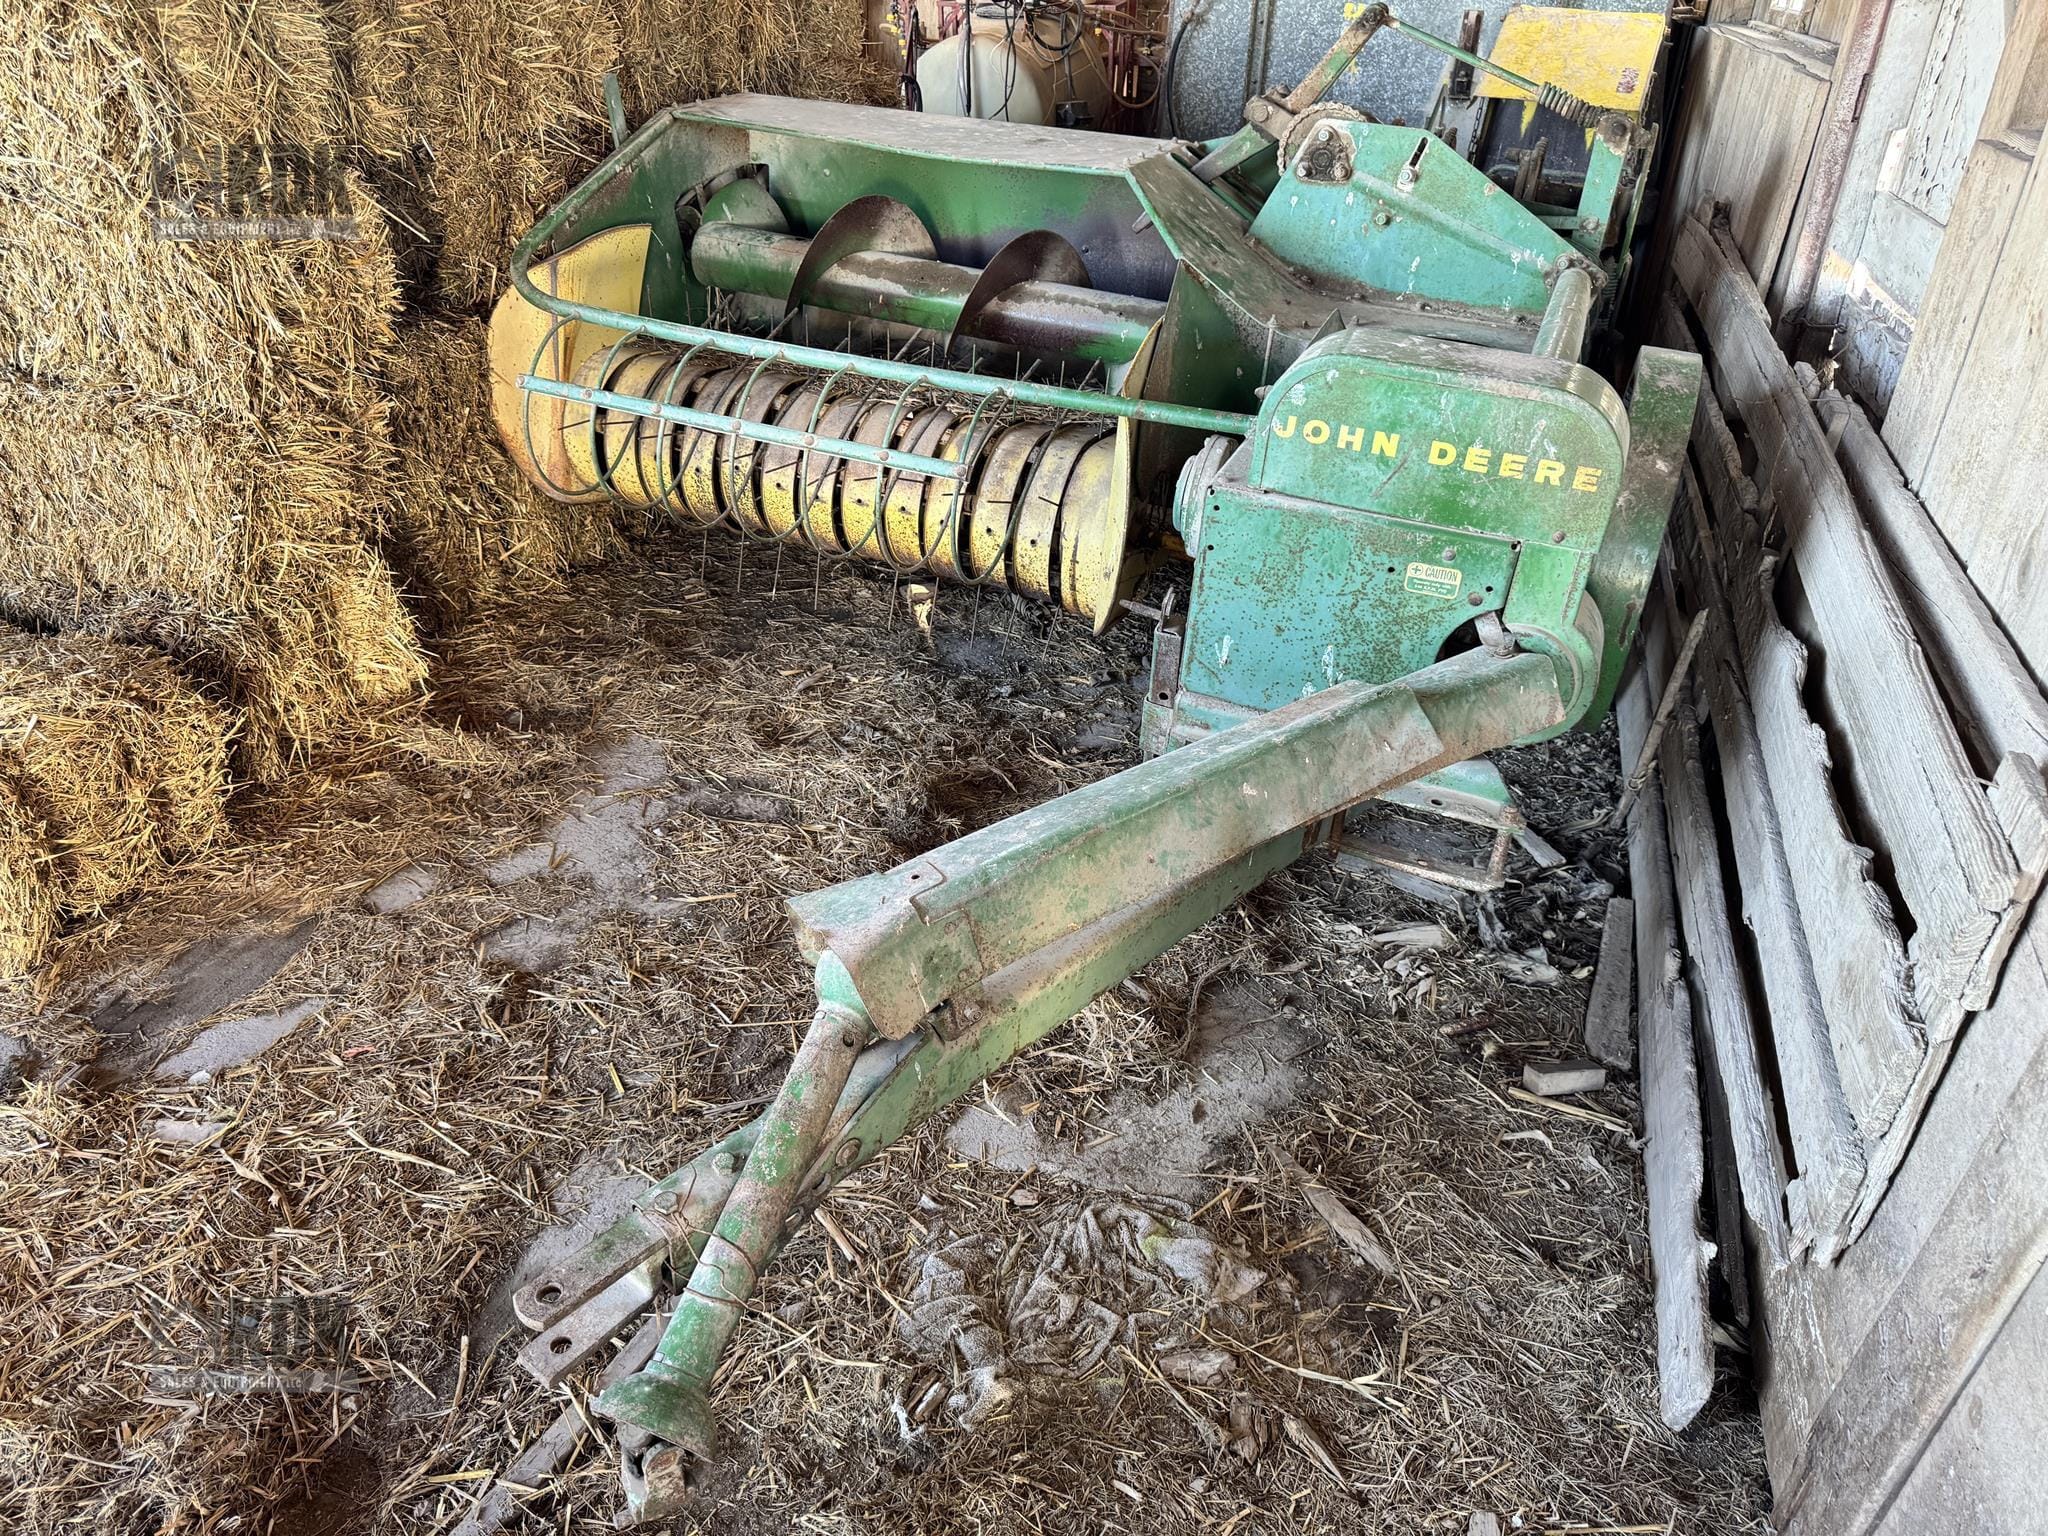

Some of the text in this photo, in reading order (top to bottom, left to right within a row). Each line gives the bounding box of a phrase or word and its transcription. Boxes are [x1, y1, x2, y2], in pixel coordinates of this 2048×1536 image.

[1274, 415, 1603, 492] JOHN DEERE
[1425, 566, 1458, 582] CAUTION
